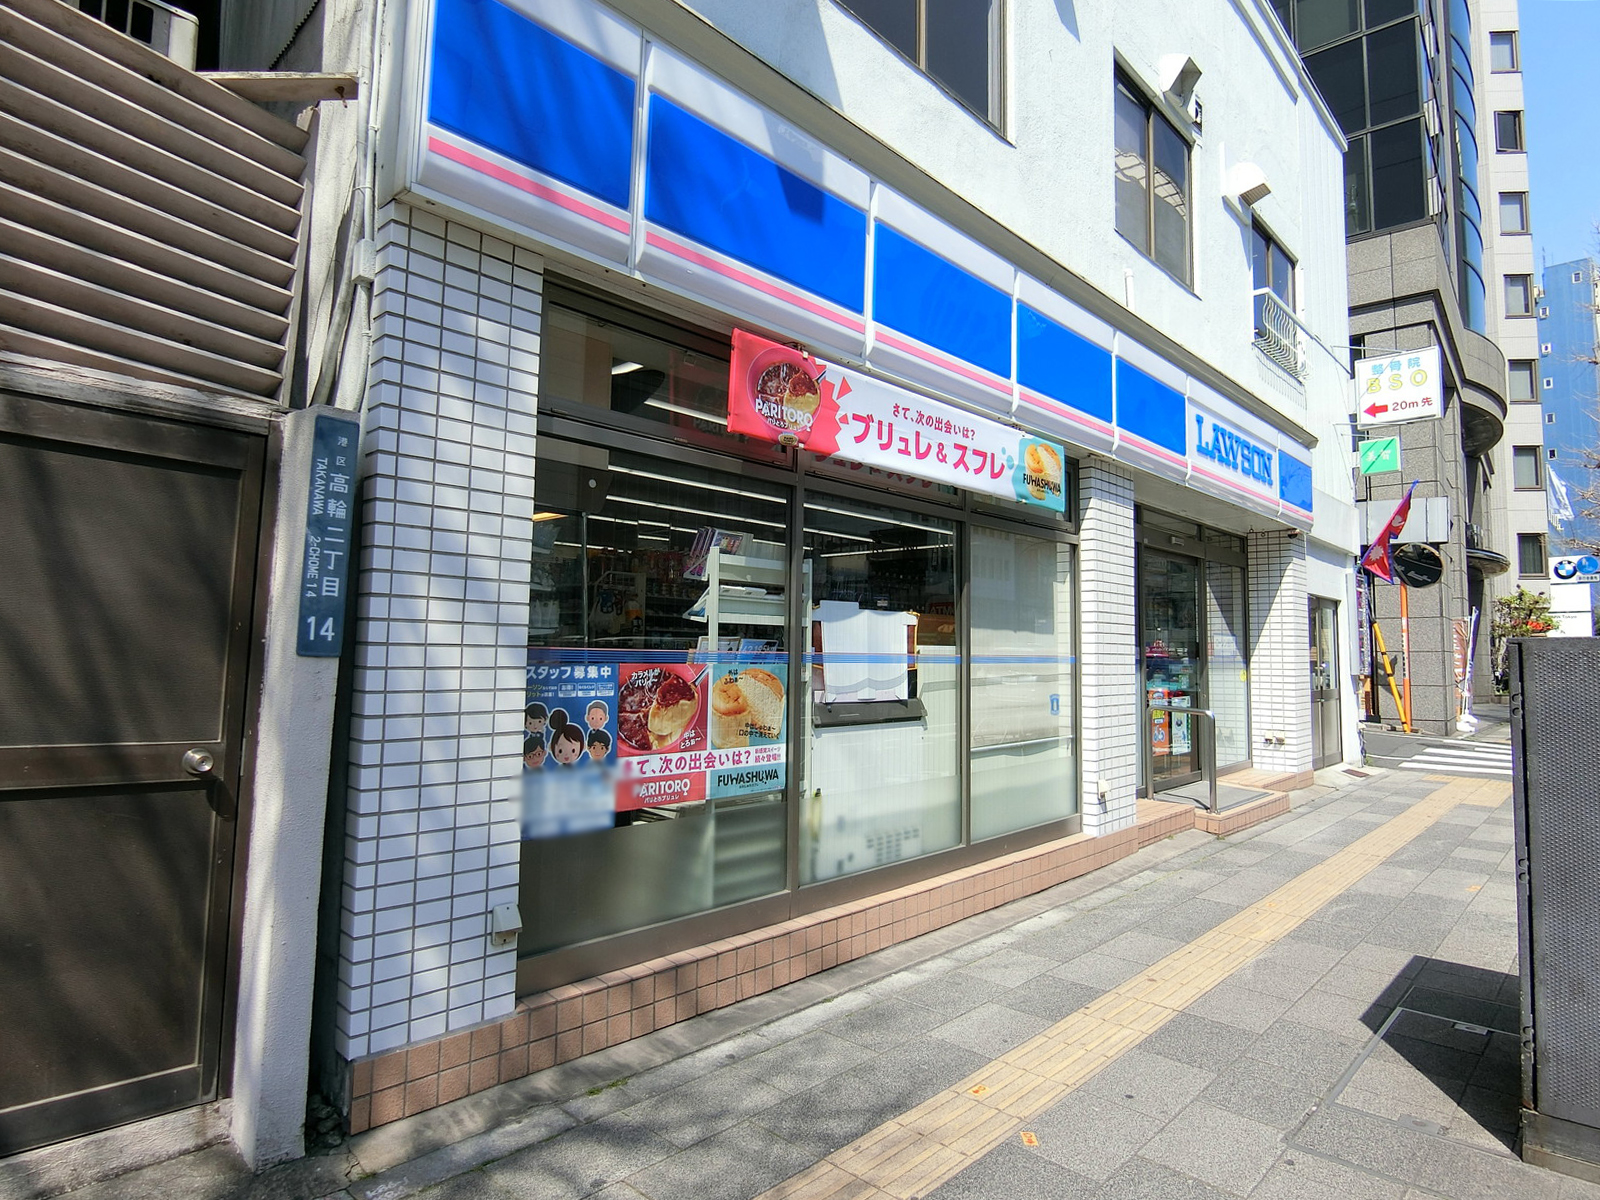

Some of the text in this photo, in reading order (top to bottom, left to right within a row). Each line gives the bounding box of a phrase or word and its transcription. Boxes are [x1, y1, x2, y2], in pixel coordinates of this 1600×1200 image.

[1371, 356, 1421, 375] 整骨院
[1366, 369, 1428, 395] BSO
[755, 398, 813, 431] PARITORO
[1391, 396, 1433, 411] 20m先
[891, 402, 977, 442] さて、次の出会いは?
[851, 412, 1006, 480] ブリュレ&スフレ
[1195, 413, 1274, 487] LAWSON
[1022, 472, 1062, 496] FUWASHUWA
[305, 457, 329, 598] TAKANAWA 2-CHOME 14
[321, 472, 351, 597] 高輪二丁目
[307, 615, 335, 642] 14
[526, 665, 612, 680] スタッフ募集中
[717, 768, 779, 788] FUWASHUWA
